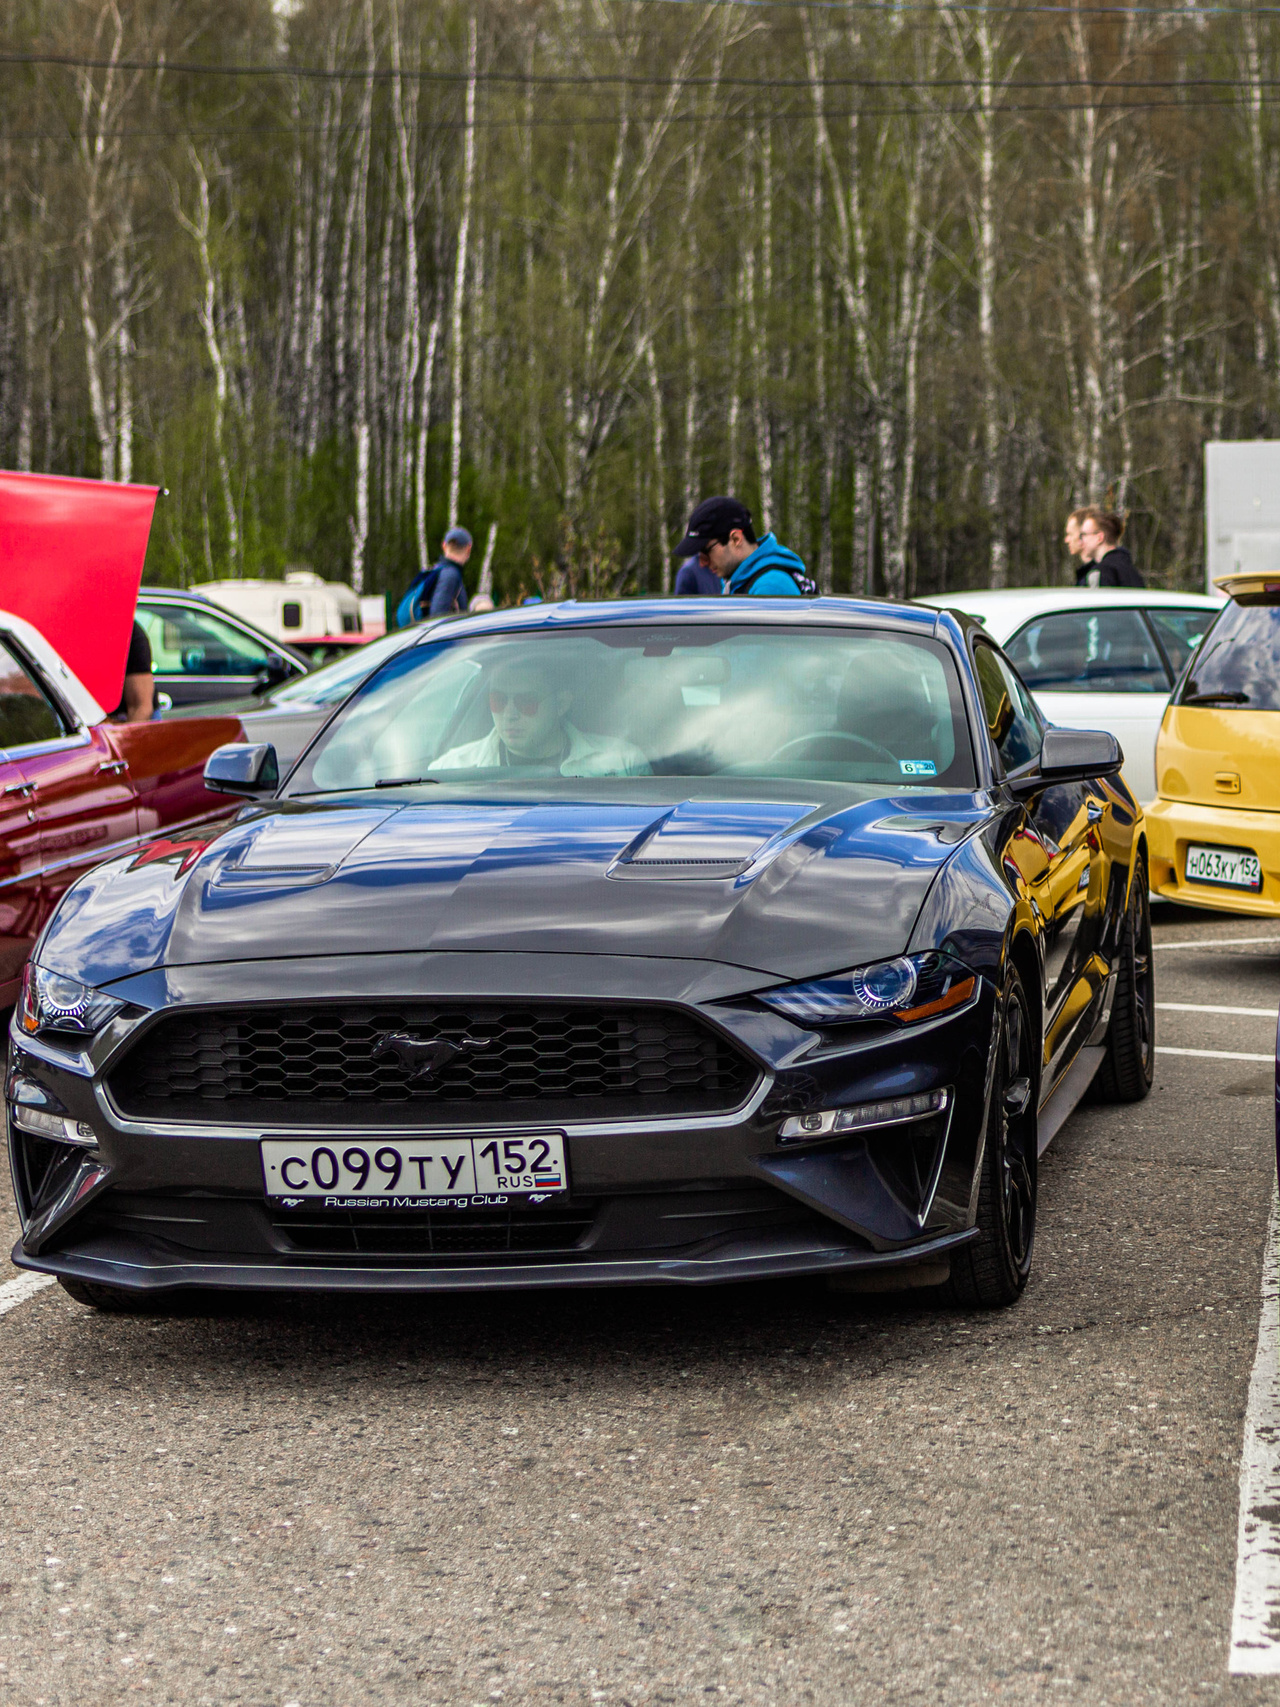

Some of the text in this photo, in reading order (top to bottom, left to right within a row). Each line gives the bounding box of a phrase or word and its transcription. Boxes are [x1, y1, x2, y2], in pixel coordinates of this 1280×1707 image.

[905, 763, 914, 772] 6
[1240, 857, 1258, 877] 152
[479, 1138, 553, 1175] 152
[497, 1175, 533, 1188] RUS
[324, 1194, 508, 1208] Russian Mustang Club
